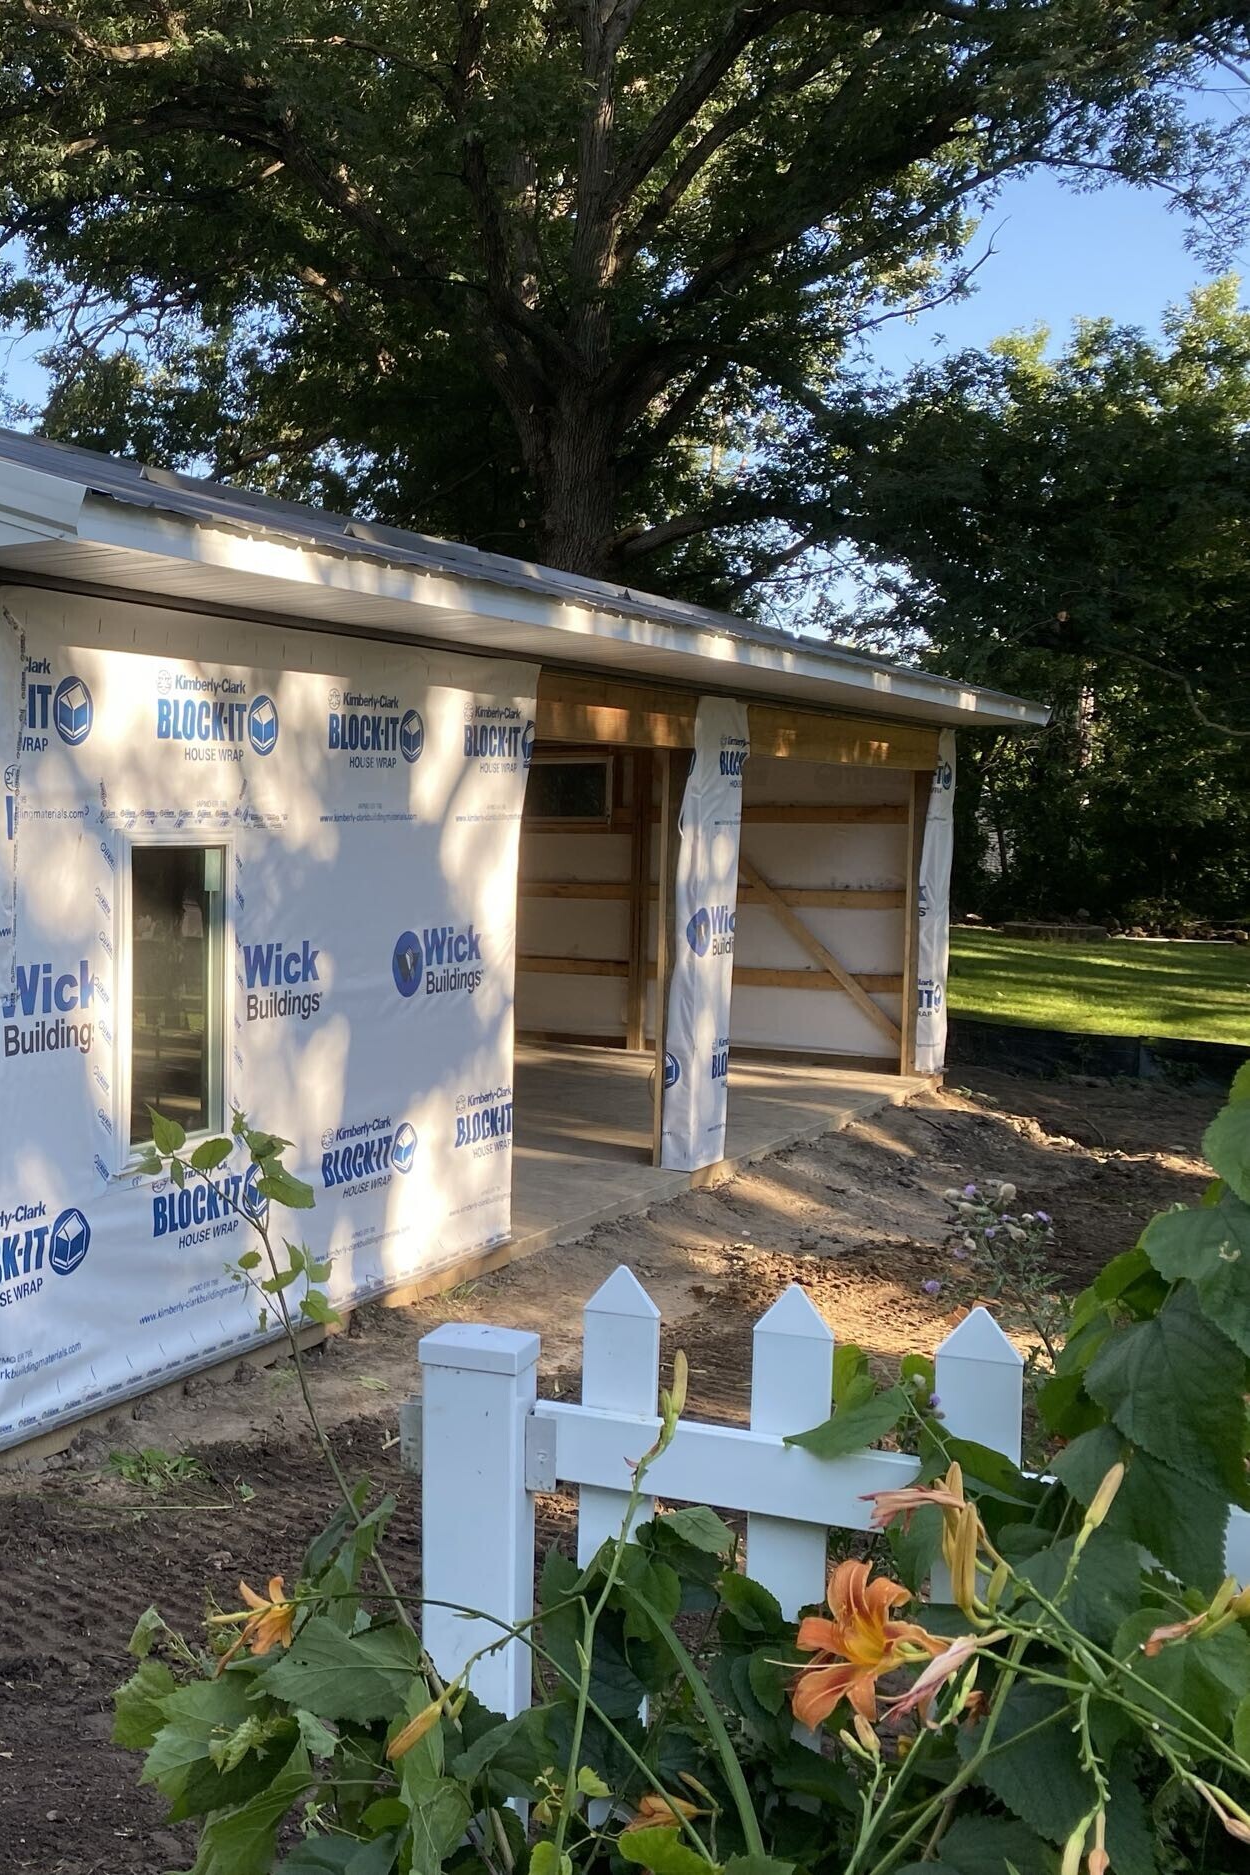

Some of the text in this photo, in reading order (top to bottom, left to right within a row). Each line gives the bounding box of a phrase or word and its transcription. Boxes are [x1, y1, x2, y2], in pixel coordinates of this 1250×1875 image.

[184, 747, 245, 762] HOUSE WRAP
[349, 756, 397, 769] HOUSE WRAP
[424, 924, 482, 966] Wick
[243, 940, 320, 989] Wick
[425, 969, 482, 995] Buildings
[246, 989, 320, 1021] Buildings
[342, 1181, 370, 1199] HOUSE
[178, 1219, 239, 1250] HOUSE WRAP
[13, 1277, 43, 1301] WRAP
